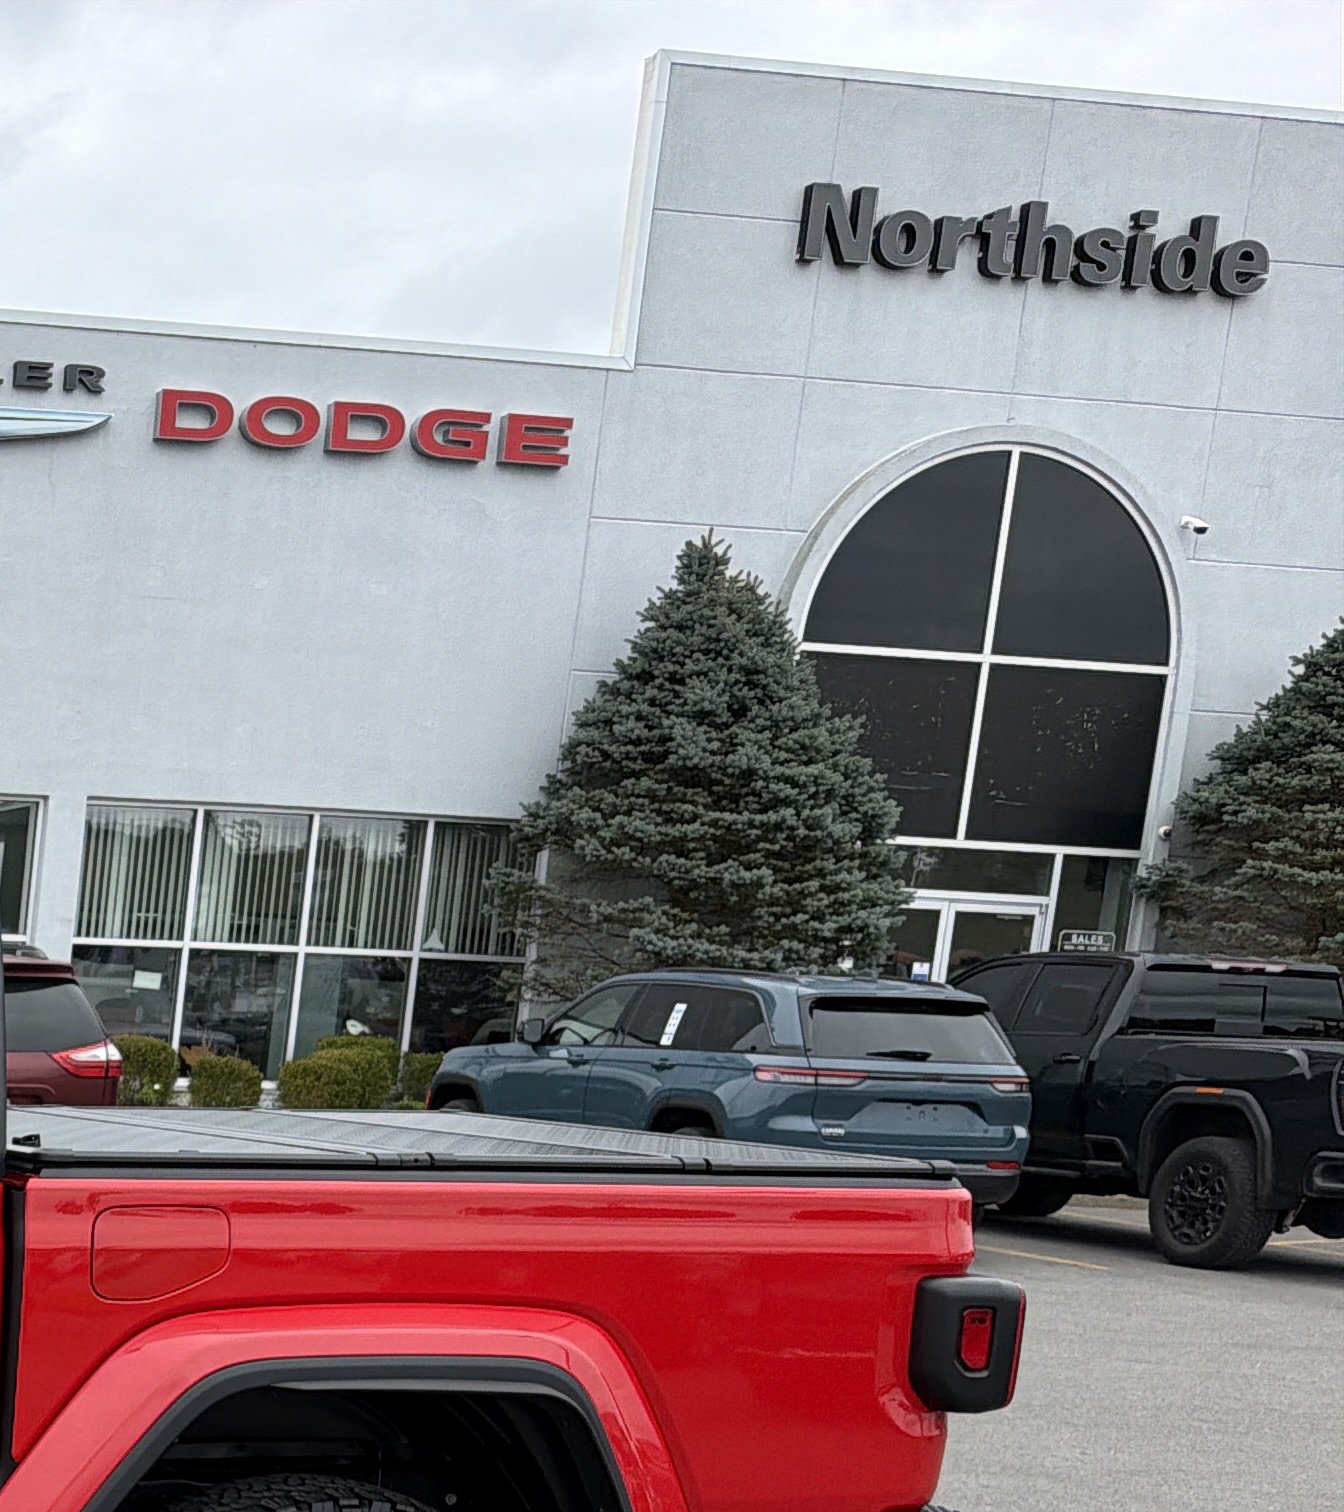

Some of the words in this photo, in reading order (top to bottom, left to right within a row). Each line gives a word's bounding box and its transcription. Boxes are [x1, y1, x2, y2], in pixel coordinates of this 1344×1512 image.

[796, 182, 1270, 297] Northside
[153, 388, 574, 470] DODGE
[1071, 934, 1104, 945] SALES
